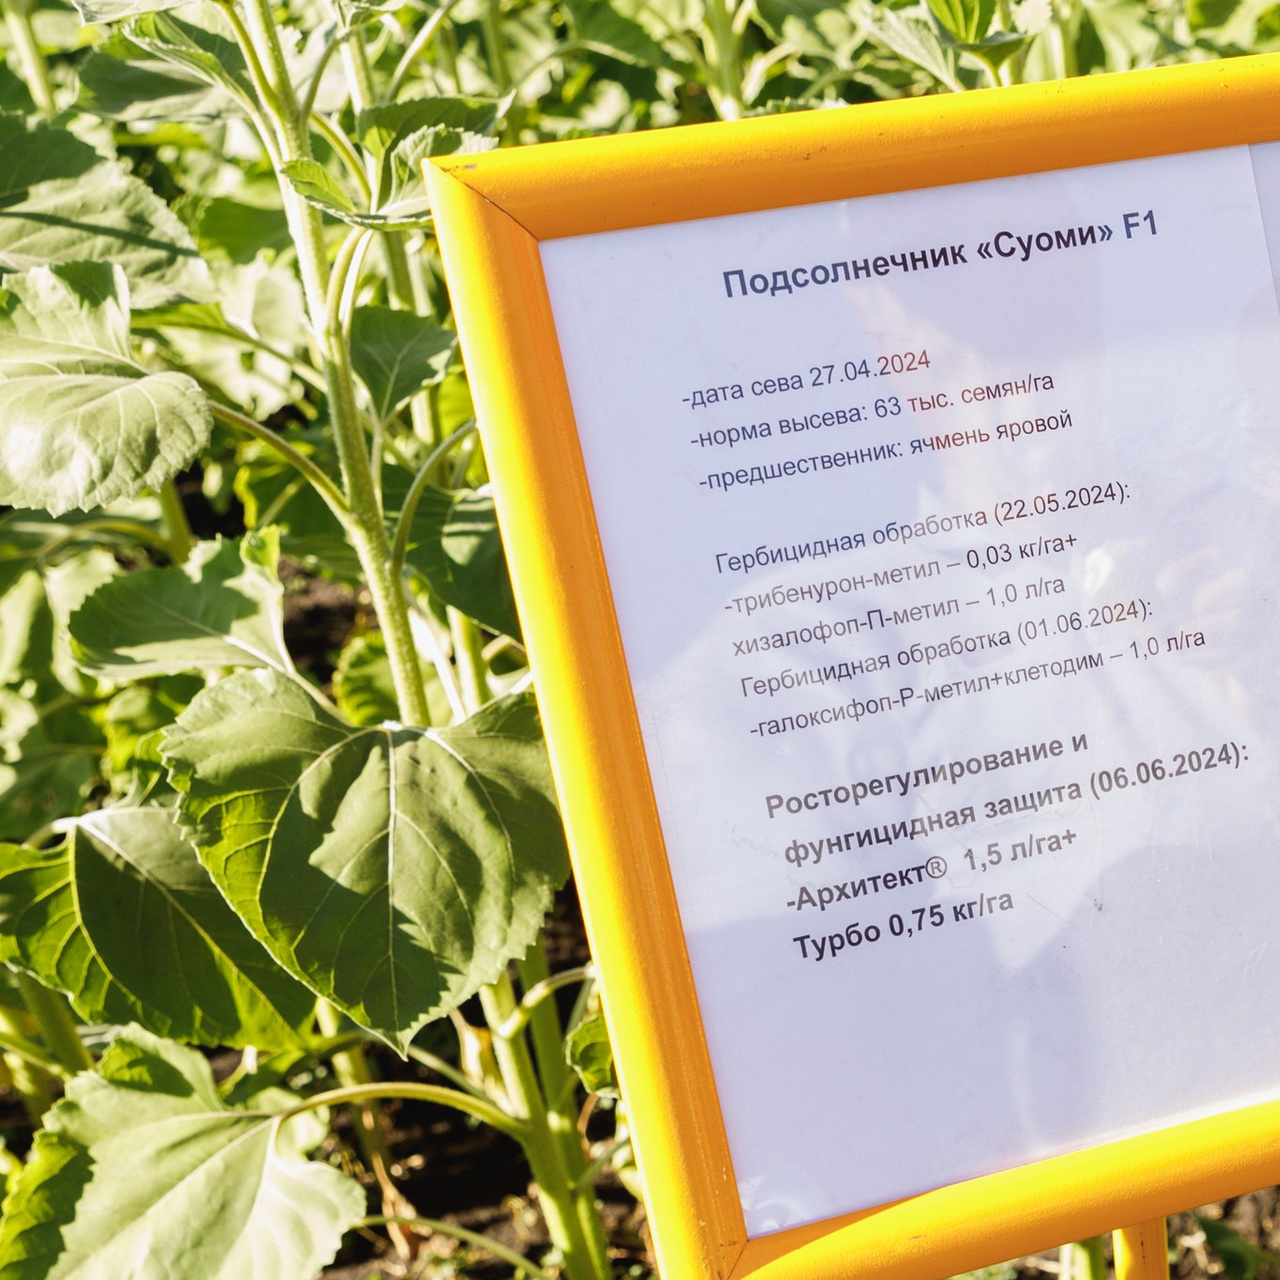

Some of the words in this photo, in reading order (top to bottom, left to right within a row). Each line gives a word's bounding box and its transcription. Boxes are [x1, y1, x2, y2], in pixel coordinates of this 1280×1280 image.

[722, 242, 967, 298] Подсолнечник
[976, 219, 1114, 261] «Суоми»
[1123, 210, 1159, 239] F1
[682, 382, 744, 409] -дата
[751, 373, 803, 397] сева
[810, 350, 930, 387] 27.04.2024
[691, 420, 772, 449] -норма
[779, 406, 868, 436] высева:
[874, 396, 901, 418] 63
[907, 392, 954, 414] тыс.
[961, 373, 1054, 405] семян/га
[910, 427, 990, 455] ячмень
[996, 409, 1072, 442] яровой
[715, 533, 866, 574] Гербицидная
[873, 510, 987, 546] обработка
[994, 482, 1131, 525] (22.05.2024):
[966, 544, 1012, 571] 0,03
[1019, 533, 1077, 561] кг/га+
[987, 584, 1017, 608] 1,0
[1024, 575, 1065, 599] л/га
[741, 653, 891, 697] Гербицидная
[898, 630, 1011, 668] обработка
[1017, 599, 1153, 647] (01.06.2024):
[1130, 638, 1160, 661] 1,0
[1166, 629, 1206, 653] л/га
[1072, 733, 1088, 753] и
[784, 805, 975, 868] фунгицидная
[985, 780, 1082, 819] защита
[1090, 741, 1249, 800] (06.06.2024):
[963, 841, 1002, 873] 1,5
[1011, 828, 1078, 862] л/га+
[794, 921, 880, 962] Турбо
[889, 904, 945, 938] 0,75
[953, 892, 1014, 924] кг/га
